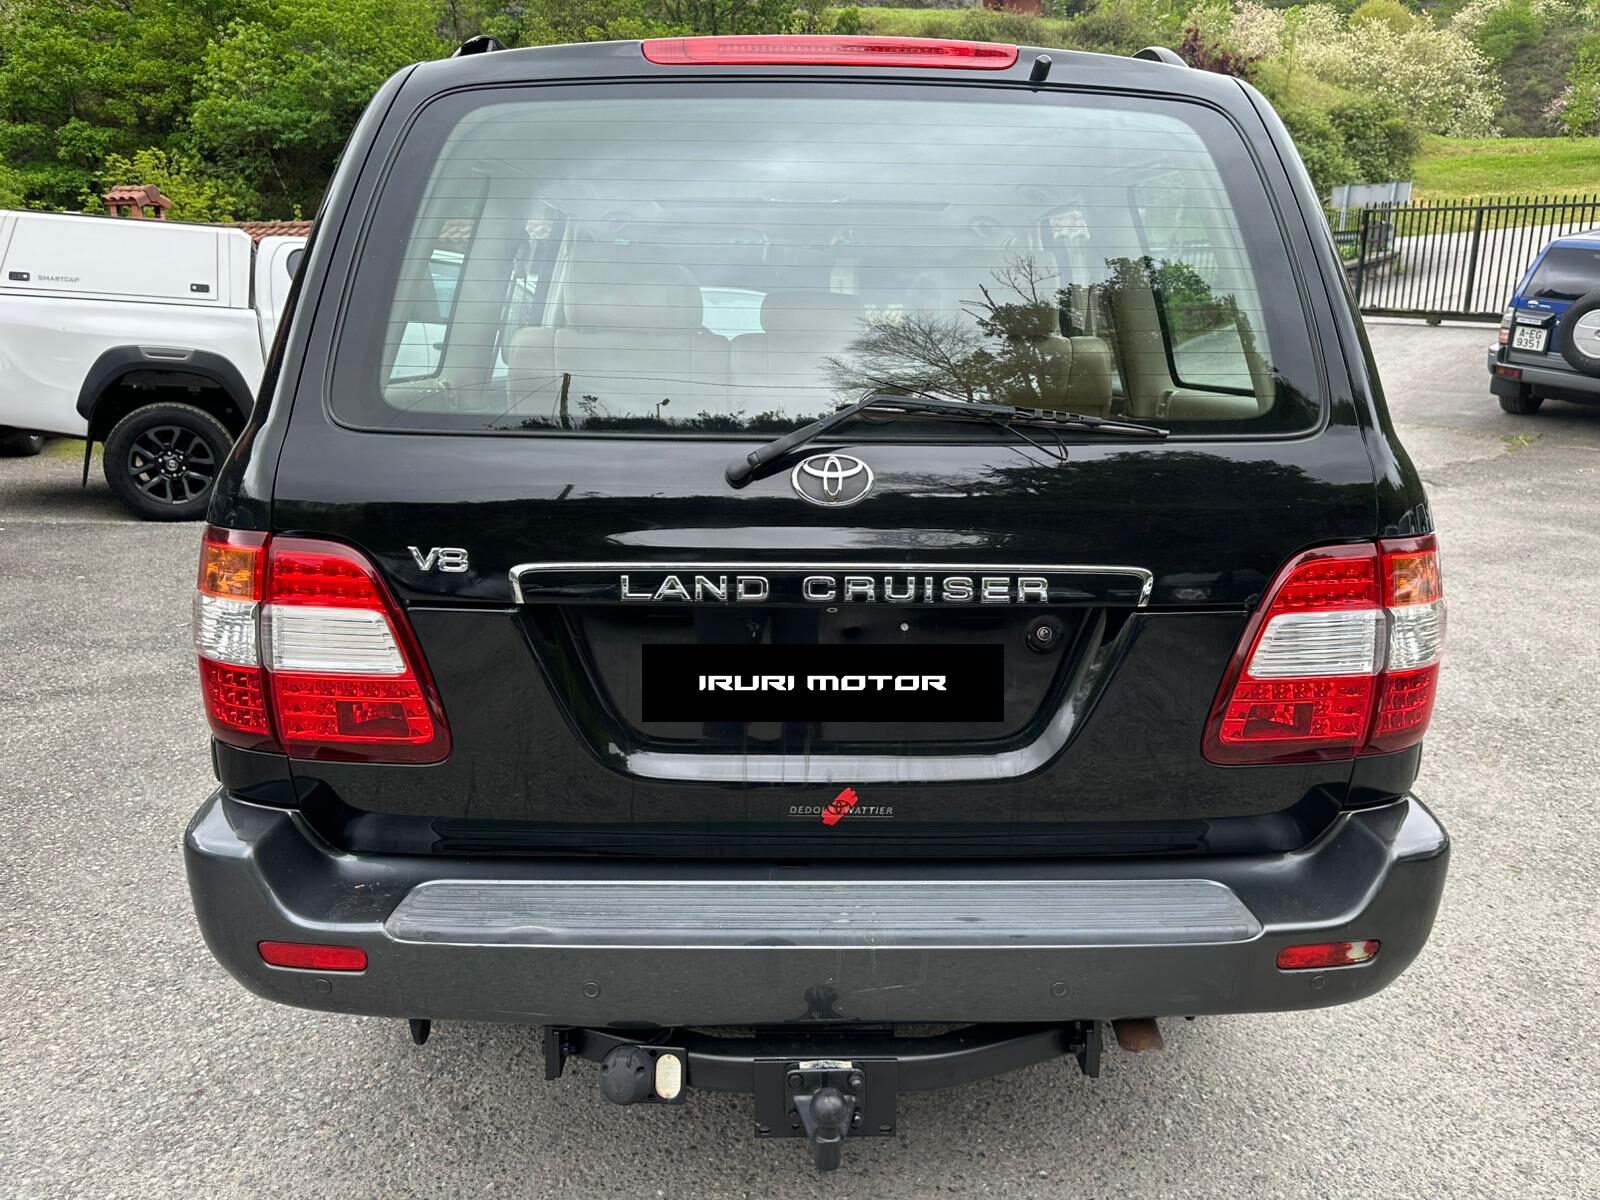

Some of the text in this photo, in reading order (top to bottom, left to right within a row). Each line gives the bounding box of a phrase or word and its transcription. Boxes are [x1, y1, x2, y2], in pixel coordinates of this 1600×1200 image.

[38, 275, 80, 283] SMARTCAP
[1516, 337, 1540, 349] 9351
[407, 545, 469, 572] V8
[620, 575, 1049, 602] LAND CRUISER
